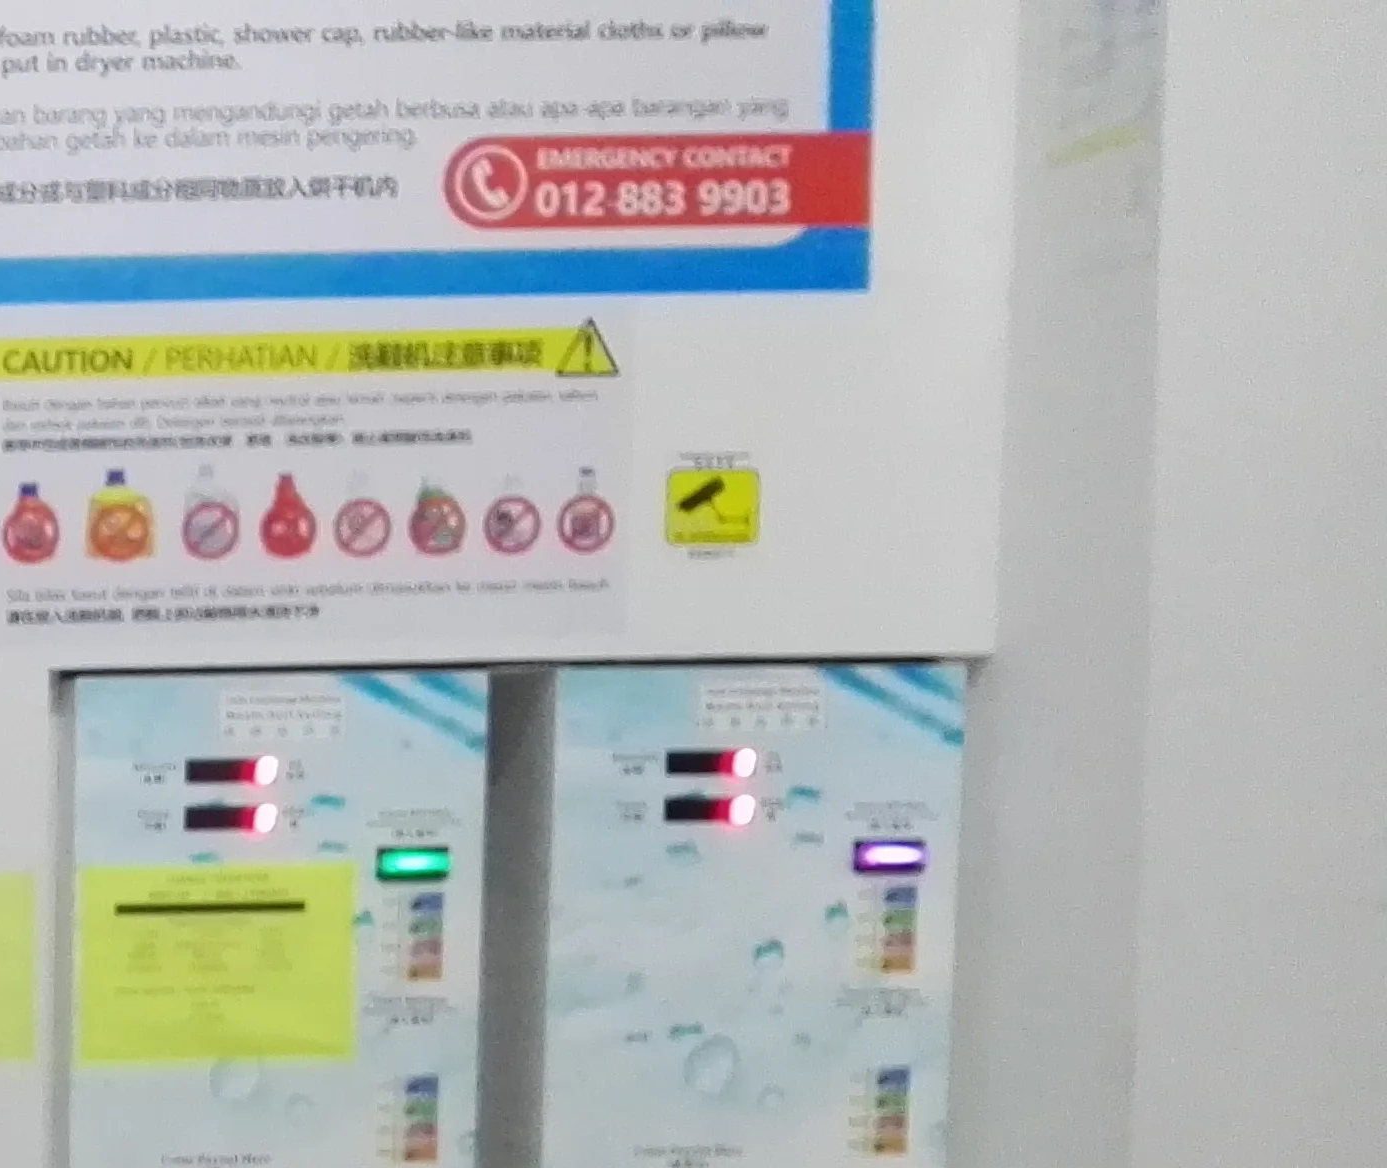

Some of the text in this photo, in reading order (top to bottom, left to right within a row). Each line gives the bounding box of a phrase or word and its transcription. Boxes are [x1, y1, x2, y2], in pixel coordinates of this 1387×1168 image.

[233, 23, 315, 46] shower
[501, 19, 589, 42] material
[670, 25, 694, 40] or
[1, 54, 39, 80] put
[47, 51, 69, 73] in
[75, 50, 134, 78] dryer
[142, 48, 243, 72] machine.
[537, 144, 793, 170] EMERGENCY CONTACT
[533, 177, 792, 217] 012 883 9903
[2, 347, 134, 375] CAUTION
[164, 344, 316, 372] PERHATIAN
